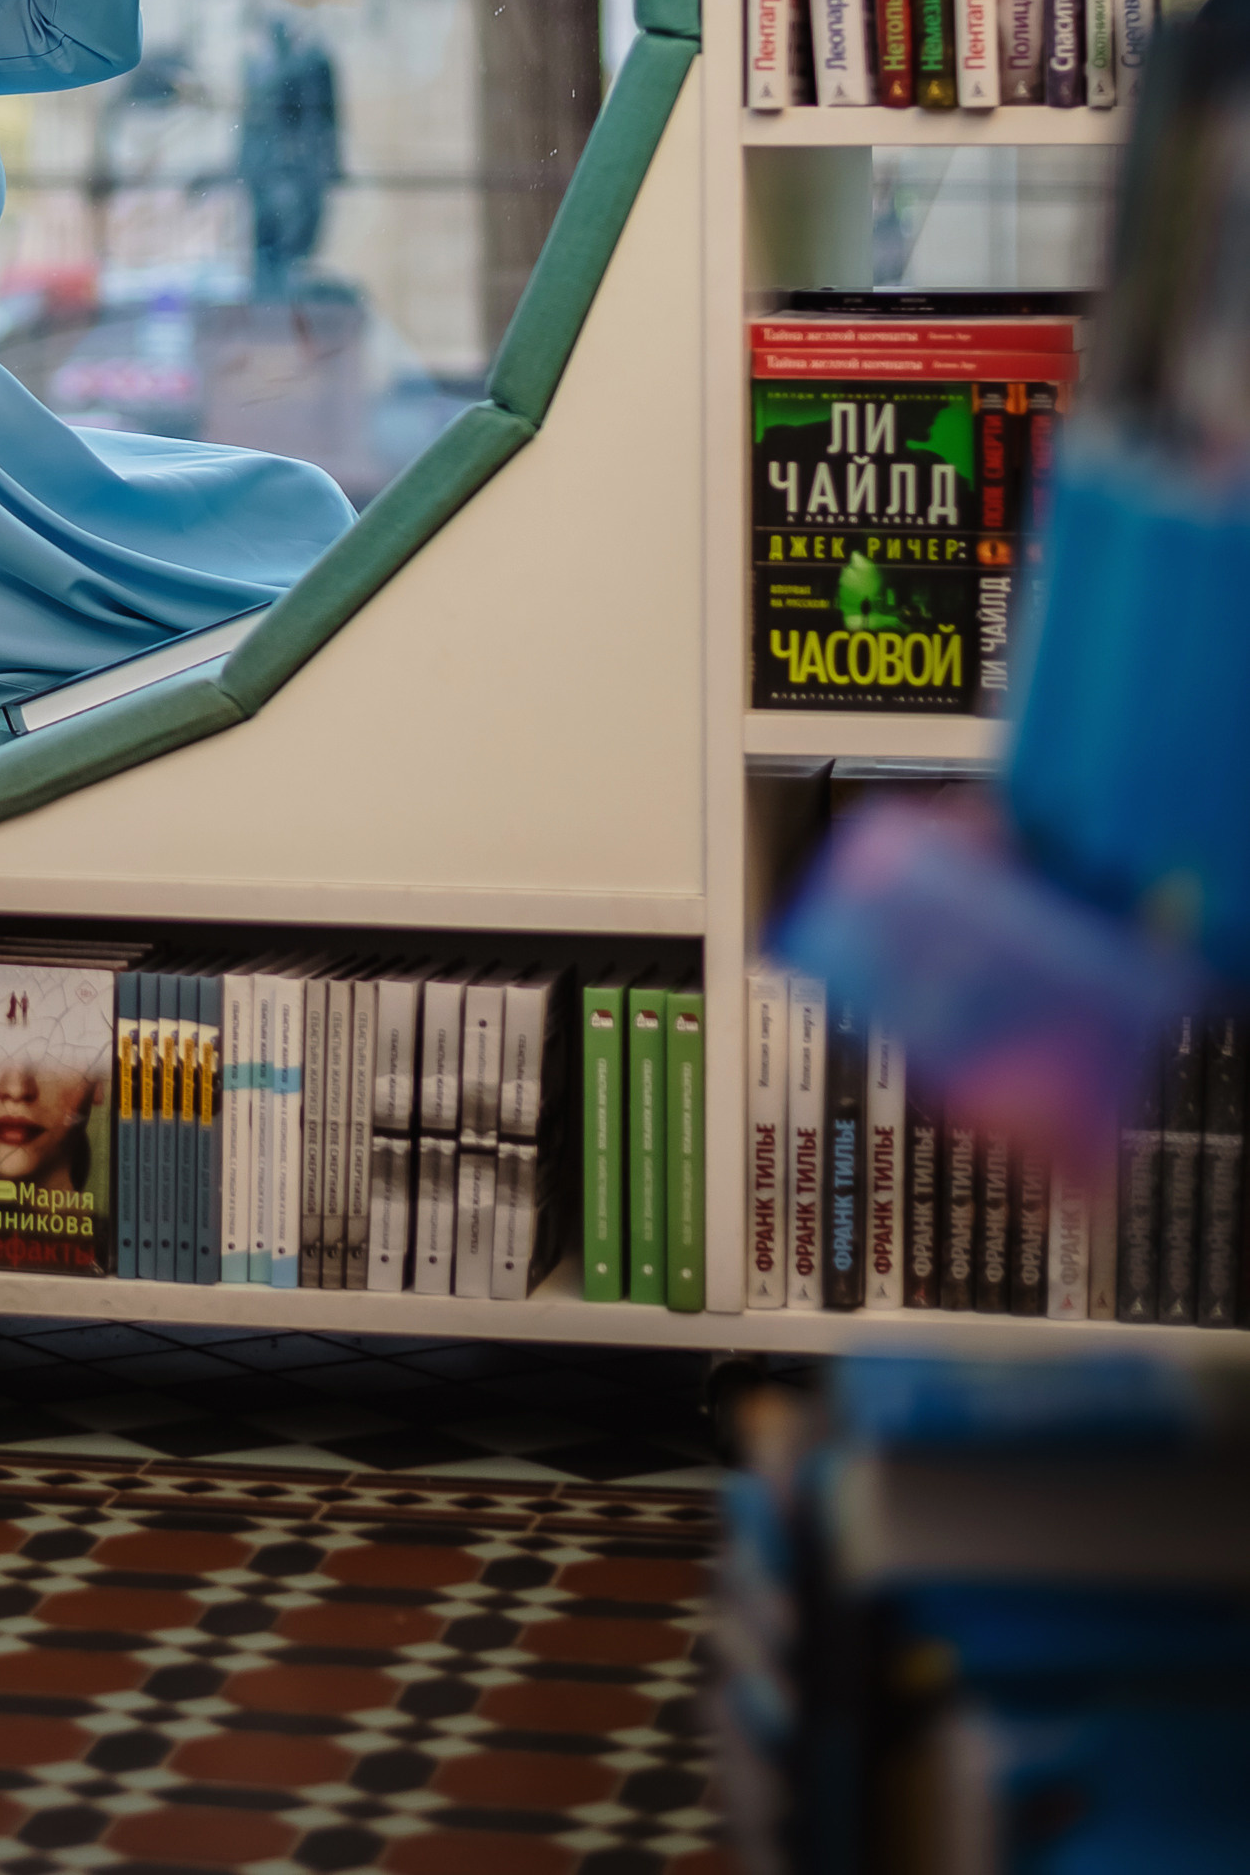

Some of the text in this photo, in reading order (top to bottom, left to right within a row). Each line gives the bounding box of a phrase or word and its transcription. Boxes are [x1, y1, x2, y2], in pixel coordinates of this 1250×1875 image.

[1091, 0, 1107, 69] Охотники
[826, 401, 896, 456] ЛИ
[767, 455, 959, 526] ЧАЙЛД
[769, 535, 968, 561] ДЖЕК РИЧЕР:
[770, 623, 963, 688] ЧАСОВОЙ
[978, 575, 1012, 692] ЛИ ЧАЙЛД
[19, 1181, 94, 1213] Мария
[306, 1148, 318, 1214] СМЕРТНИКОВ
[327, 1148, 340, 1215] СМЕРТНИКОВ
[352, 1149, 365, 1215] СМЕРТНИКОВ
[754, 1123, 777, 1273] ФРАНК ТИЛЬЕ
[794, 1127, 817, 1276] ФРАНК ТИЛЬЕ
[831, 1118, 855, 1271] ФРАНК ТИЛЬЕ
[872, 1125, 895, 1275] ФРАНК ТИЛЬЕ
[911, 1126, 934, 1277] ФРАНК ТИЛЬЕ
[949, 1129, 974, 1280] ФРАНК ТИЛЬЕ
[984, 1207, 1007, 1283] ФРАНК
[1020, 1209, 1043, 1285] ФРАНК
